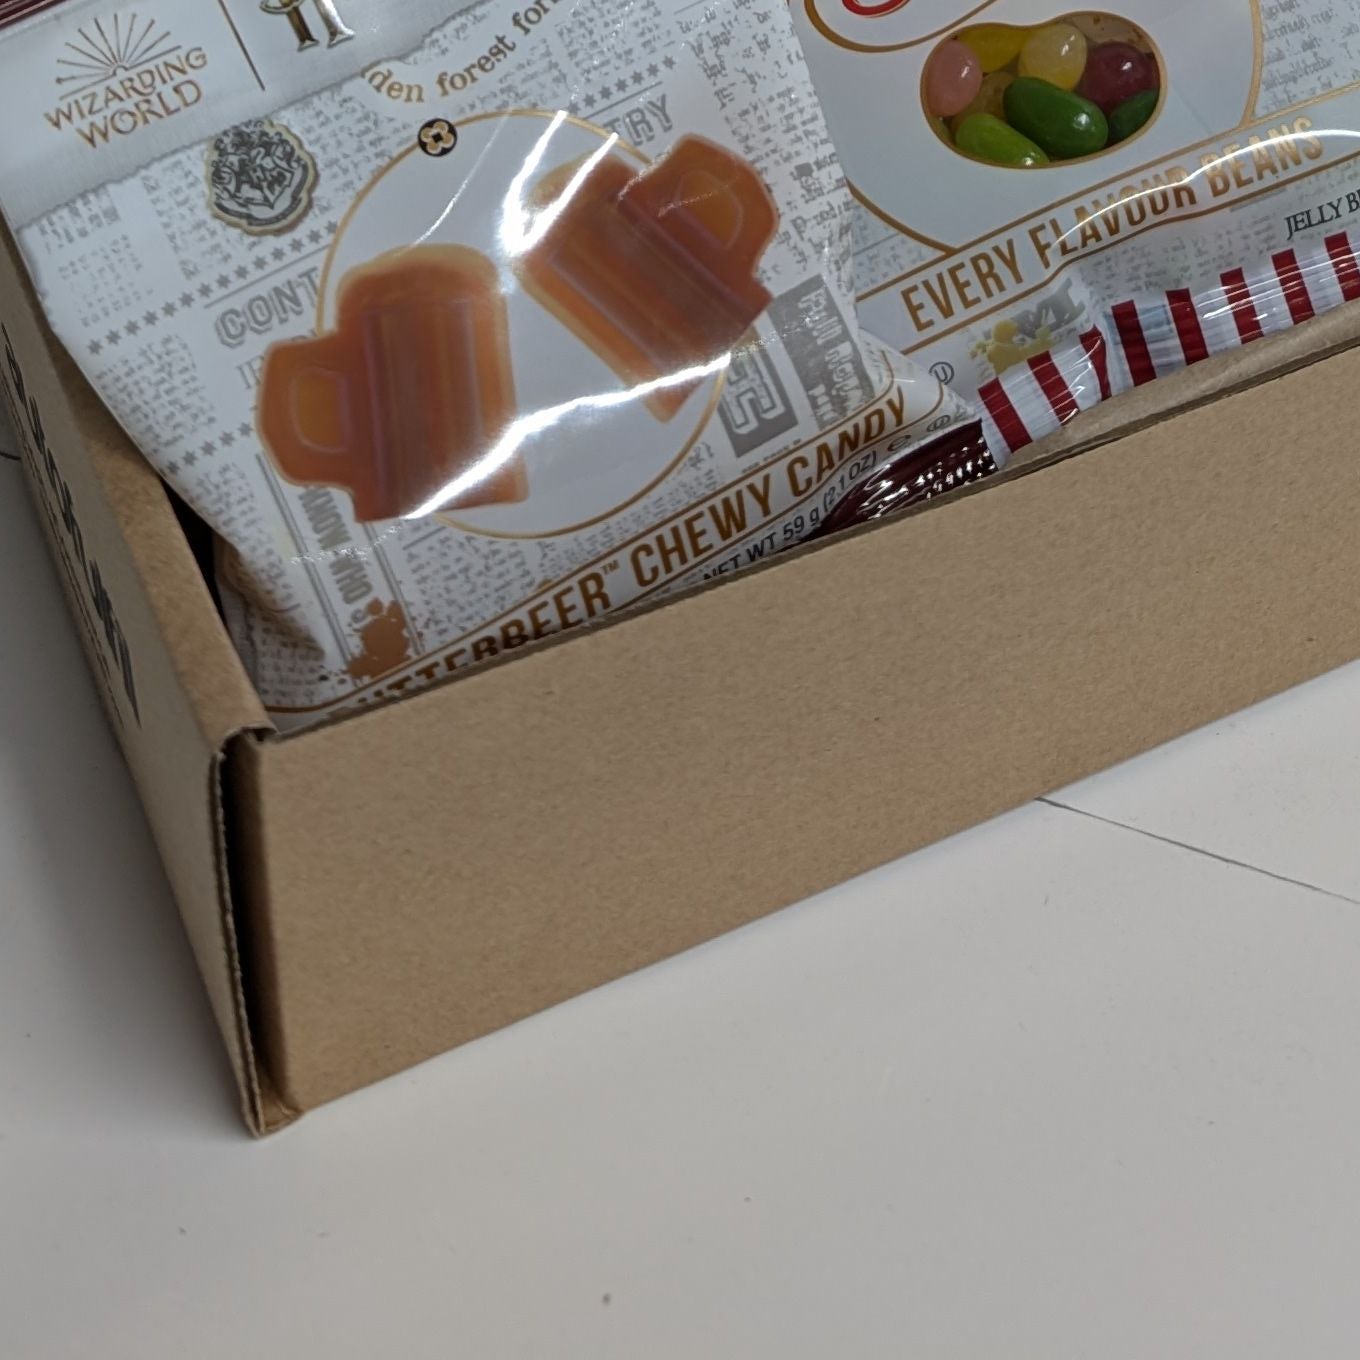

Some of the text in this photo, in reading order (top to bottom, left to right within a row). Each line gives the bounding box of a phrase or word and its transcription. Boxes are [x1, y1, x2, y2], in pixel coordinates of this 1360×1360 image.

[43, 46, 208, 131] WIZARDING
[435, 33, 517, 98] forest
[75, 78, 203, 149] WORLD
[901, 237, 1025, 333] EVERY
[1029, 174, 1198, 270] FLAVOUR
[1197, 116, 1324, 201] BEANS
[1284, 197, 1344, 241] JELLY
[630, 473, 772, 588] CHEWY
[785, 385, 905, 498] CANDY
[745, 534, 777, 563] WT
[783, 515, 806, 542] 59
